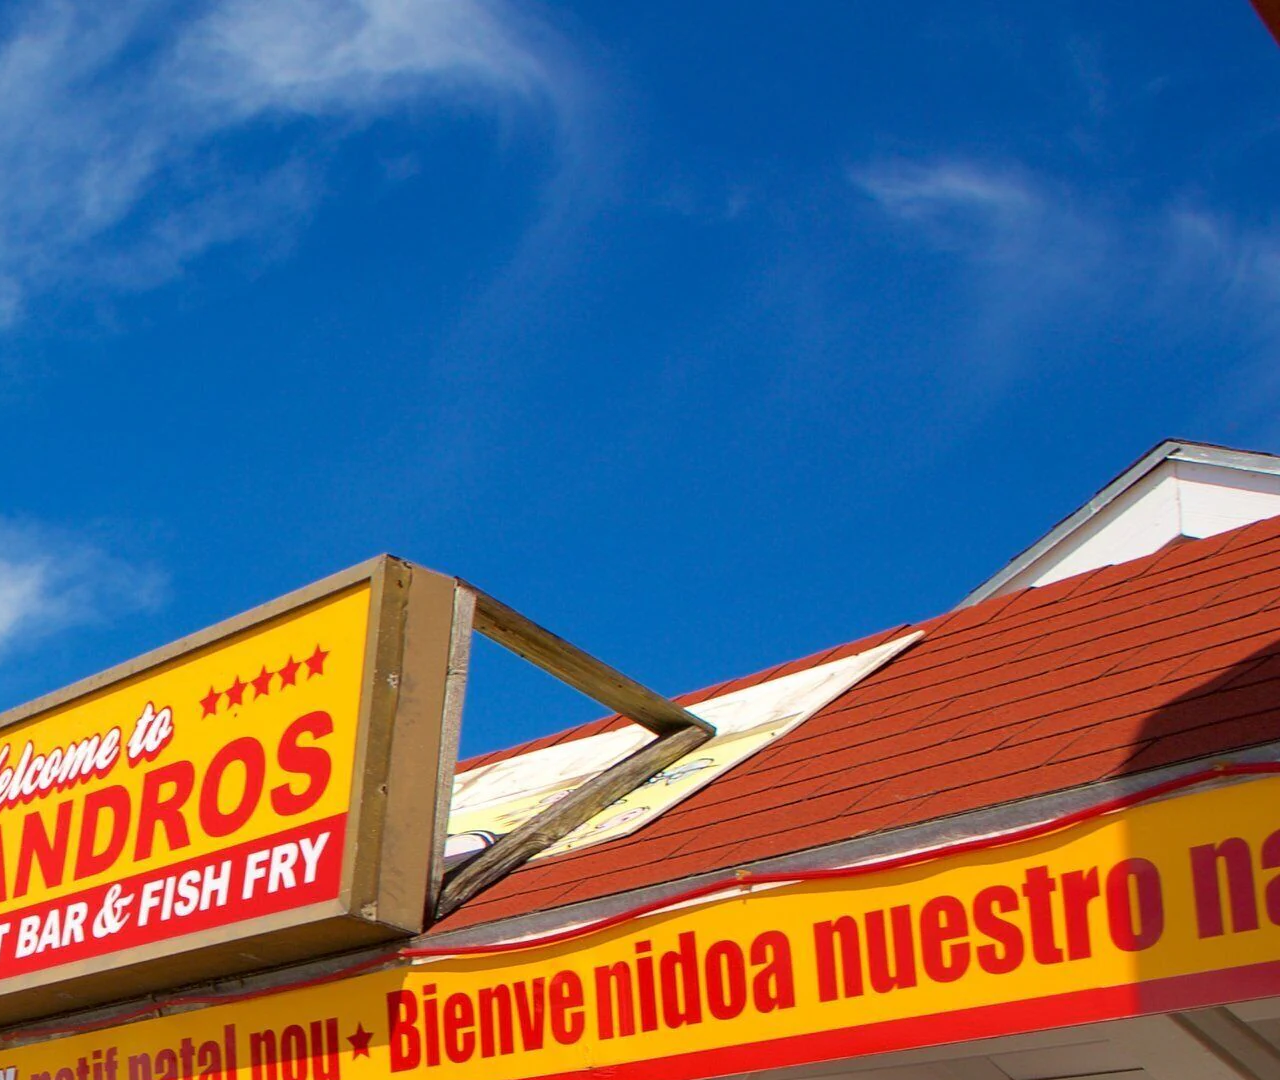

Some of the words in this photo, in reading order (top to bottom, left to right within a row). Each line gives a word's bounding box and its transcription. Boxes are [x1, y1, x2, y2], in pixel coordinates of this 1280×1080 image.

[128, 701, 174, 763] to
[17, 902, 86, 962] BAR
[93, 882, 131, 938] &
[137, 858, 229, 926] FISH
[242, 831, 332, 899] FRY
[813, 857, 1164, 1002] nuestro
